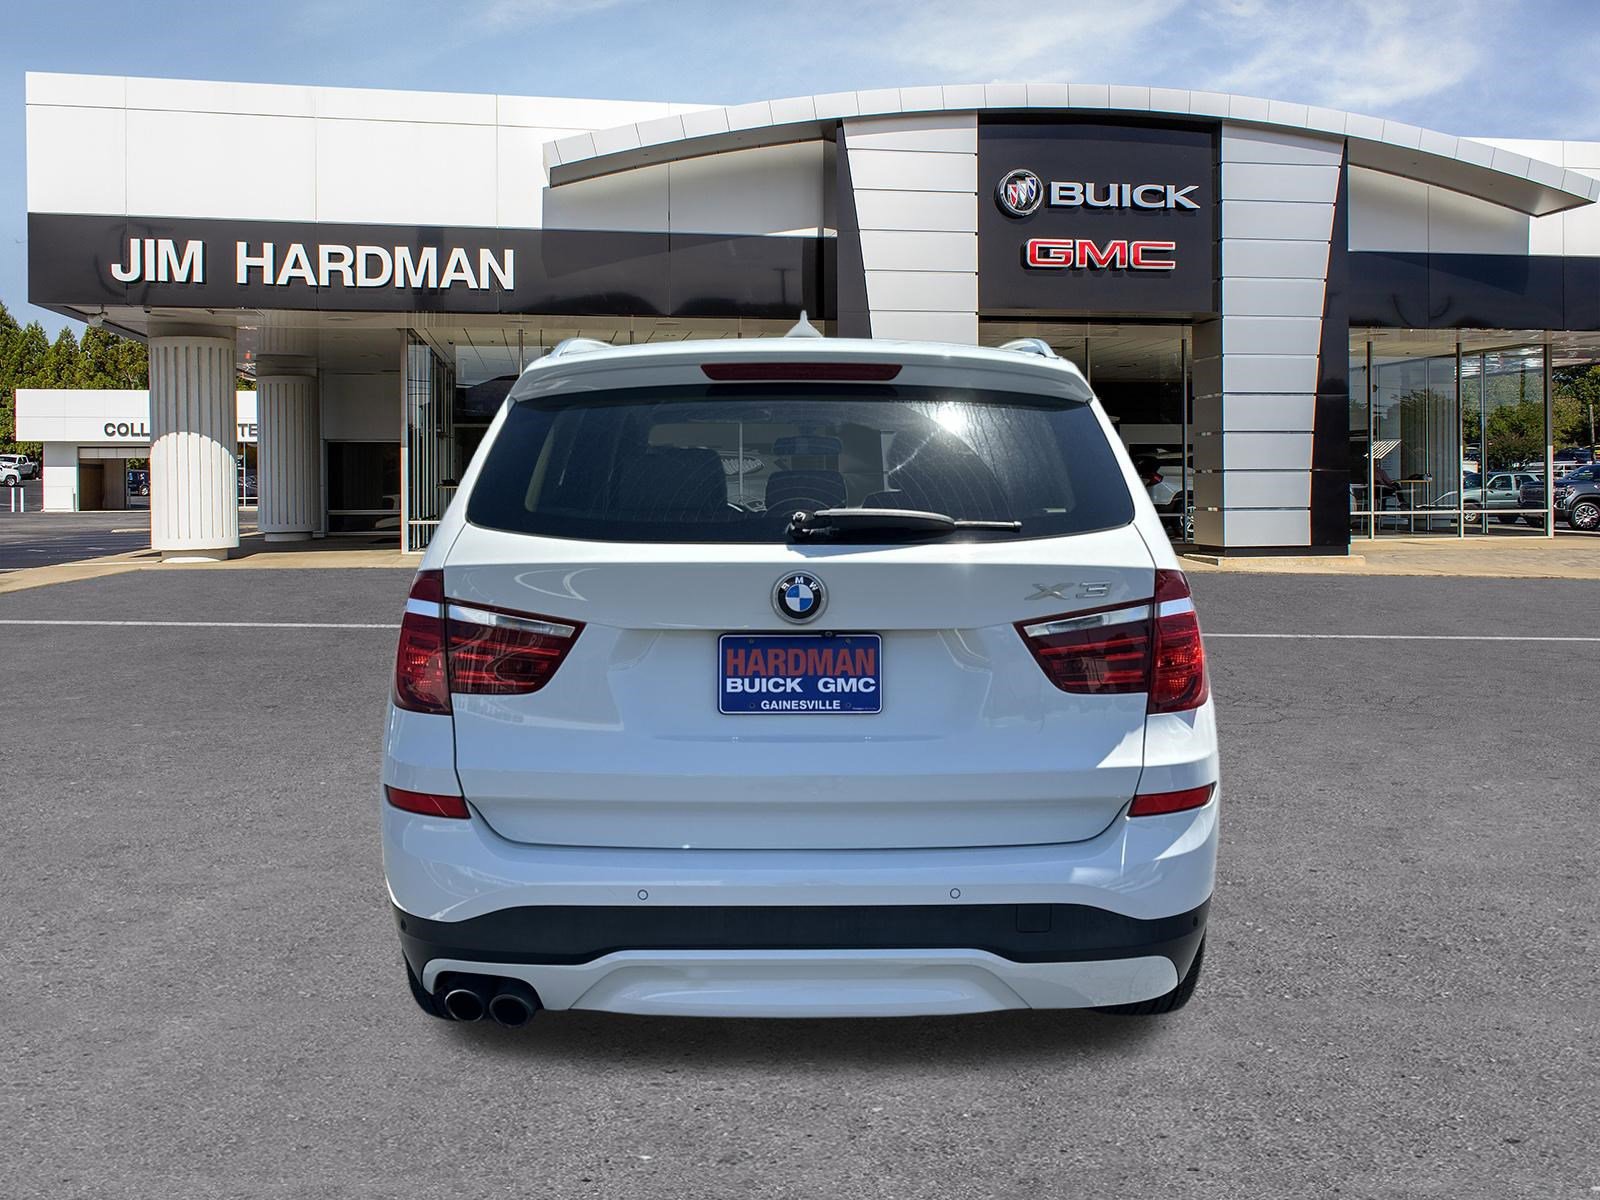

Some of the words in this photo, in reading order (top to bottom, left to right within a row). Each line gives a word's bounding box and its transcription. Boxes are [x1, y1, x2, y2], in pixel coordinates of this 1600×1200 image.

[1050, 181, 1200, 210] BUICK
[1026, 238, 1176, 270] GMC
[111, 238, 204, 284] JIM
[235, 241, 515, 291] HARDMAN
[104, 422, 150, 437] COLL
[237, 423, 257, 438] TE
[781, 576, 818, 591] BMW
[1023, 581, 1112, 600] X3
[726, 648, 875, 676] HARDMAN
[726, 677, 803, 693] BUICK
[817, 677, 876, 693] GMC
[760, 699, 841, 710] GAINESVILLE
